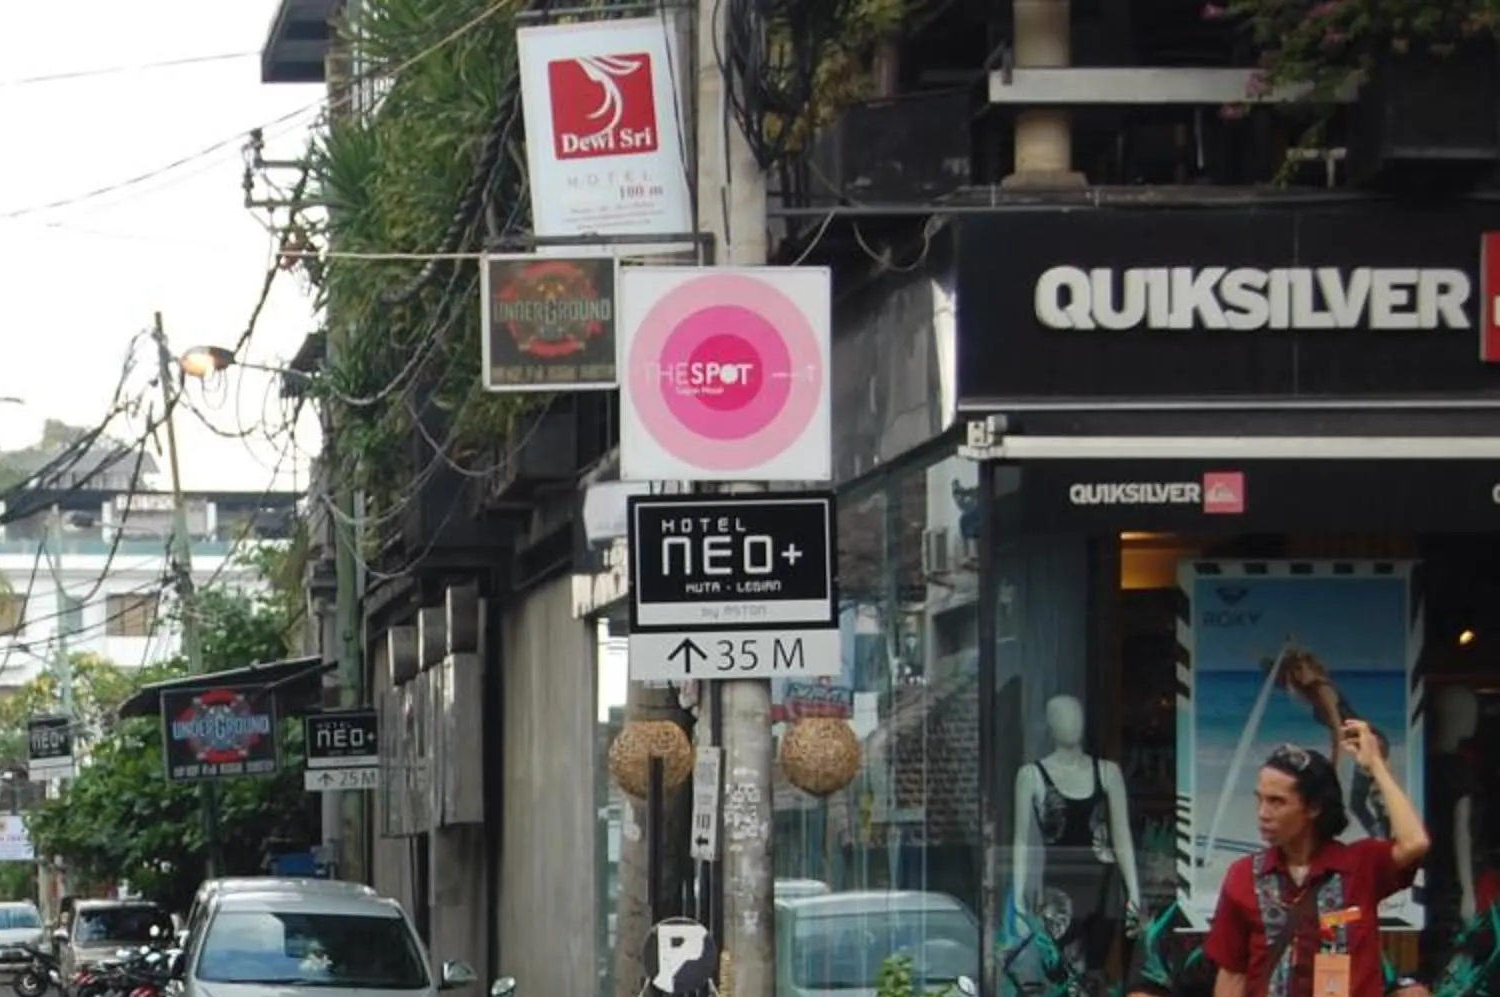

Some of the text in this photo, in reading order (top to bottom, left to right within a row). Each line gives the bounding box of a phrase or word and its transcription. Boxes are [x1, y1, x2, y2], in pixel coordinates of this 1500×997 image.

[562, 127, 653, 153] Dewi Sri
[492, 298, 613, 325] UNDERGROUND
[1034, 265, 1471, 331] QUIKSILVER
[1068, 482, 1201, 505] QUIKSILVER
[661, 518, 747, 533] HOTEL
[716, 637, 805, 671] 35 M
[172, 711, 271, 742] UNDERGROUND
[339, 771, 377, 786] 25 M
[652, 923, 710, 994] P
